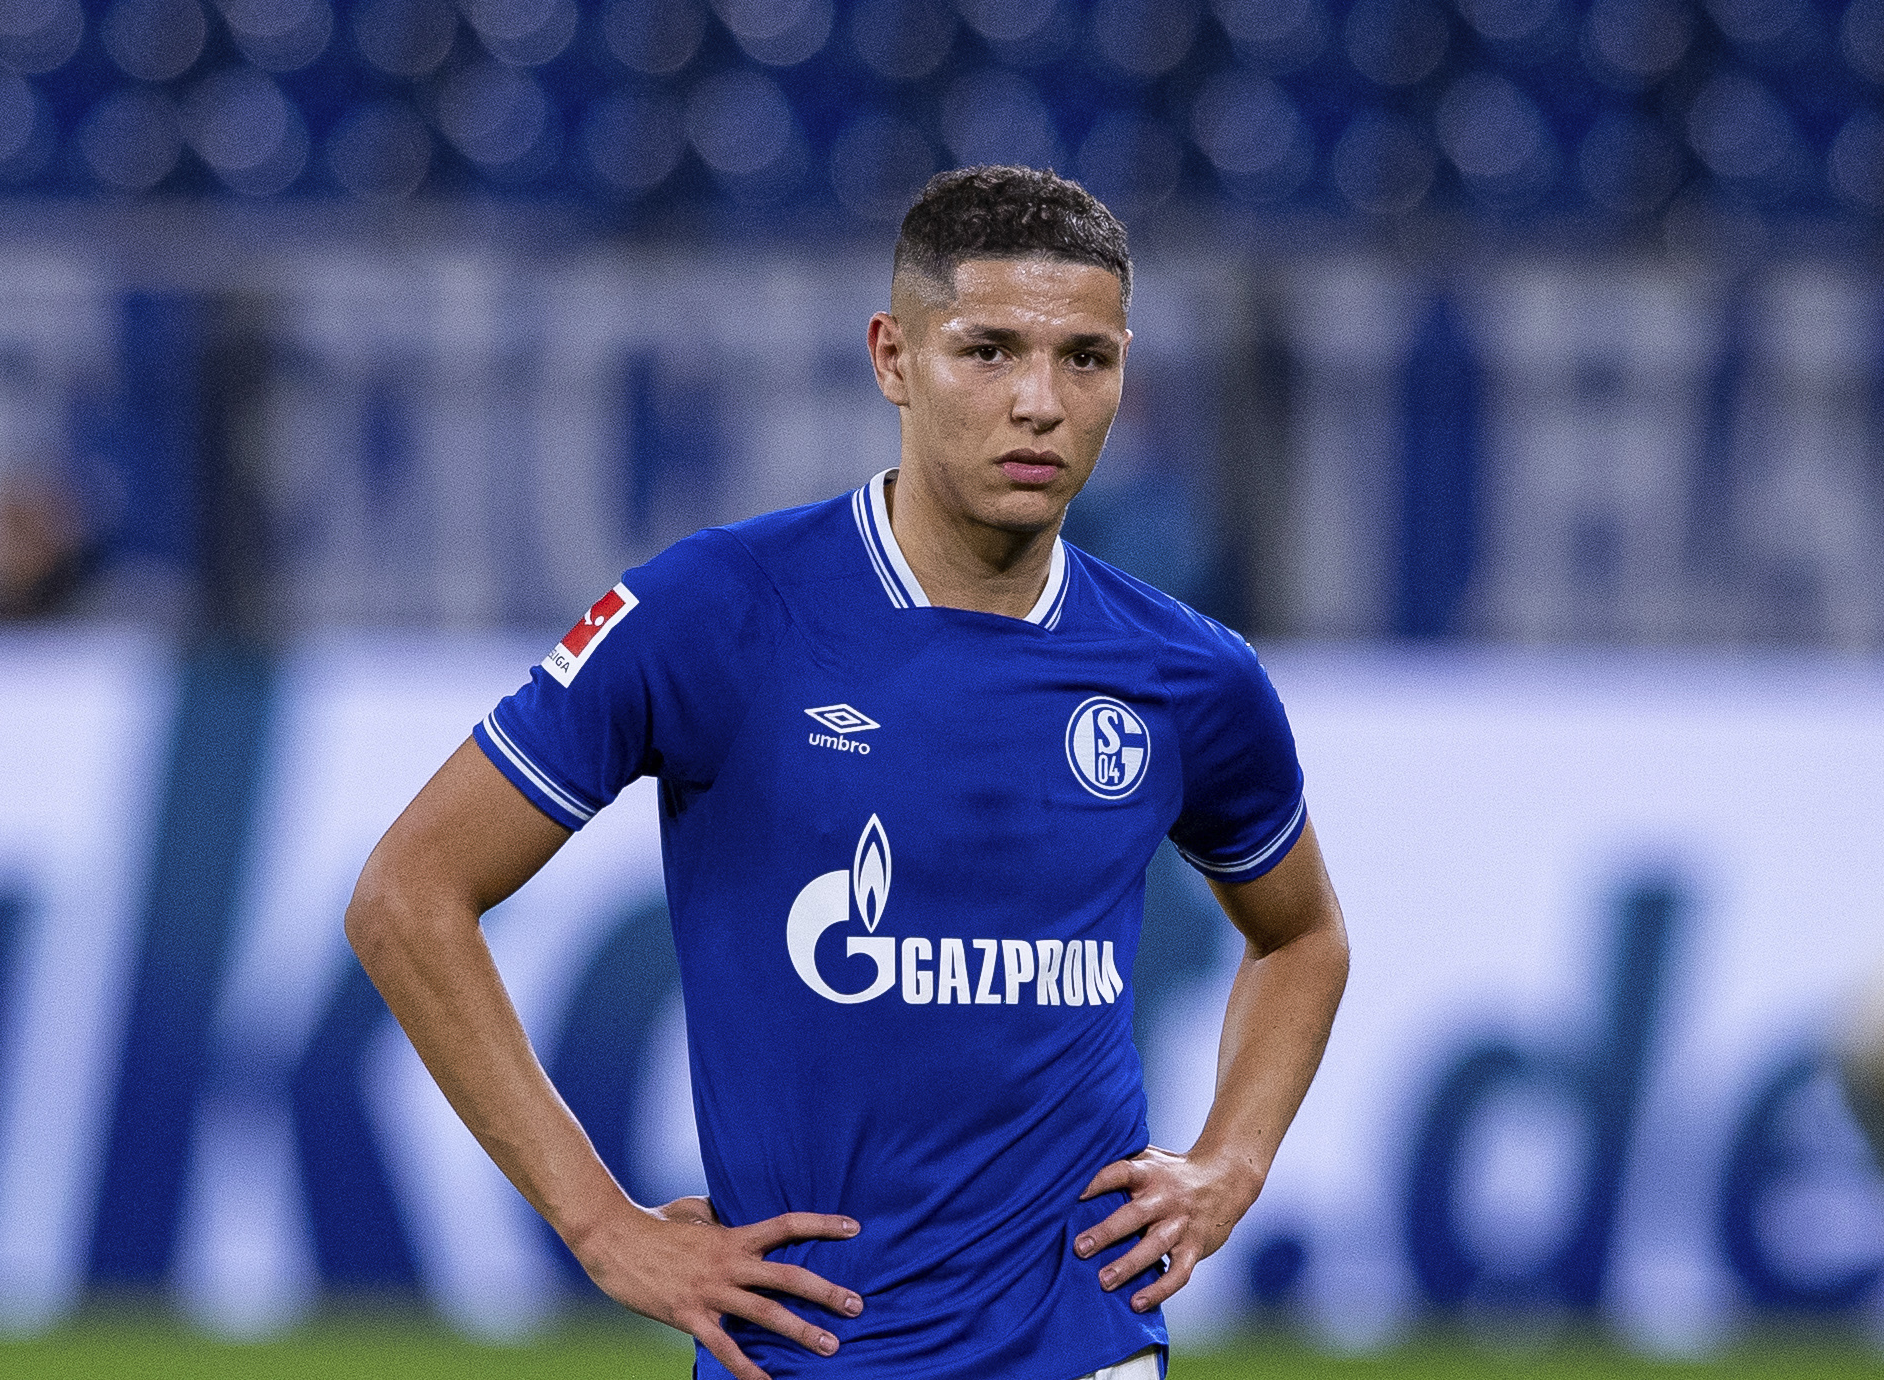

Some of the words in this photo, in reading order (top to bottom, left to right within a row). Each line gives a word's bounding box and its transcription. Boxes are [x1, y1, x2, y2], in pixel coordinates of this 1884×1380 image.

[808, 733, 871, 755] umbro
[1097, 711, 1120, 754] S
[1097, 755, 1120, 784] 04
[901, 936, 1124, 1007] GAZPROM
